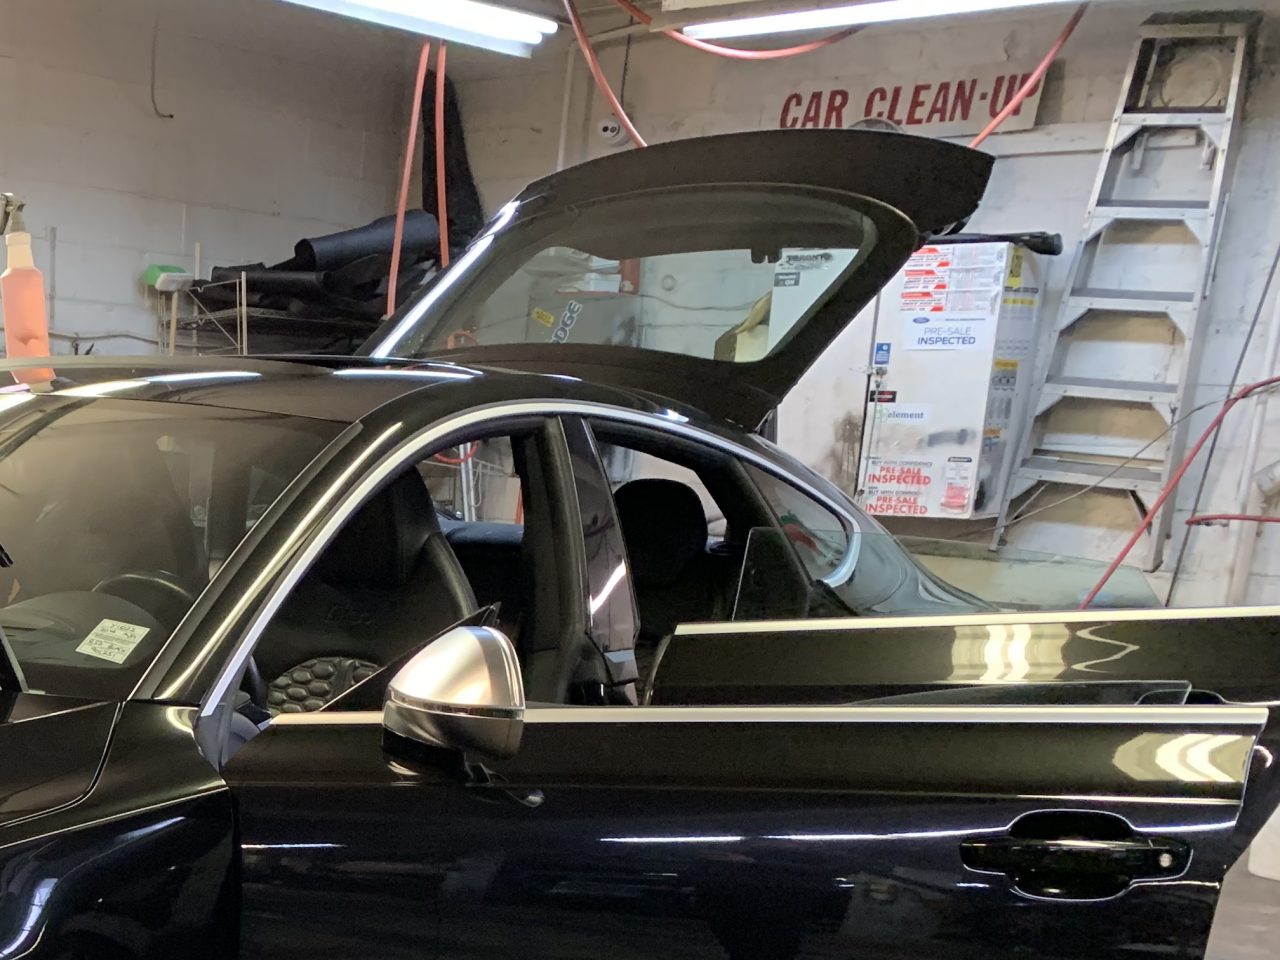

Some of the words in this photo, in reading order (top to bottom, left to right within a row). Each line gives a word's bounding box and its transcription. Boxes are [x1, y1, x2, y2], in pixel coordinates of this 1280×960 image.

[780, 89, 849, 129] CAR
[551, 300, 583, 343] DGE
[923, 326, 972, 336] PRE-SALE
[917, 336, 976, 345] INSPECTED
[887, 410, 924, 419] element
[880, 466, 922, 475] PRE-SALE
[868, 473, 932, 486] INSPECTED
[876, 496, 918, 505] PRE-SALE
[865, 503, 928, 515] INSPECTED
